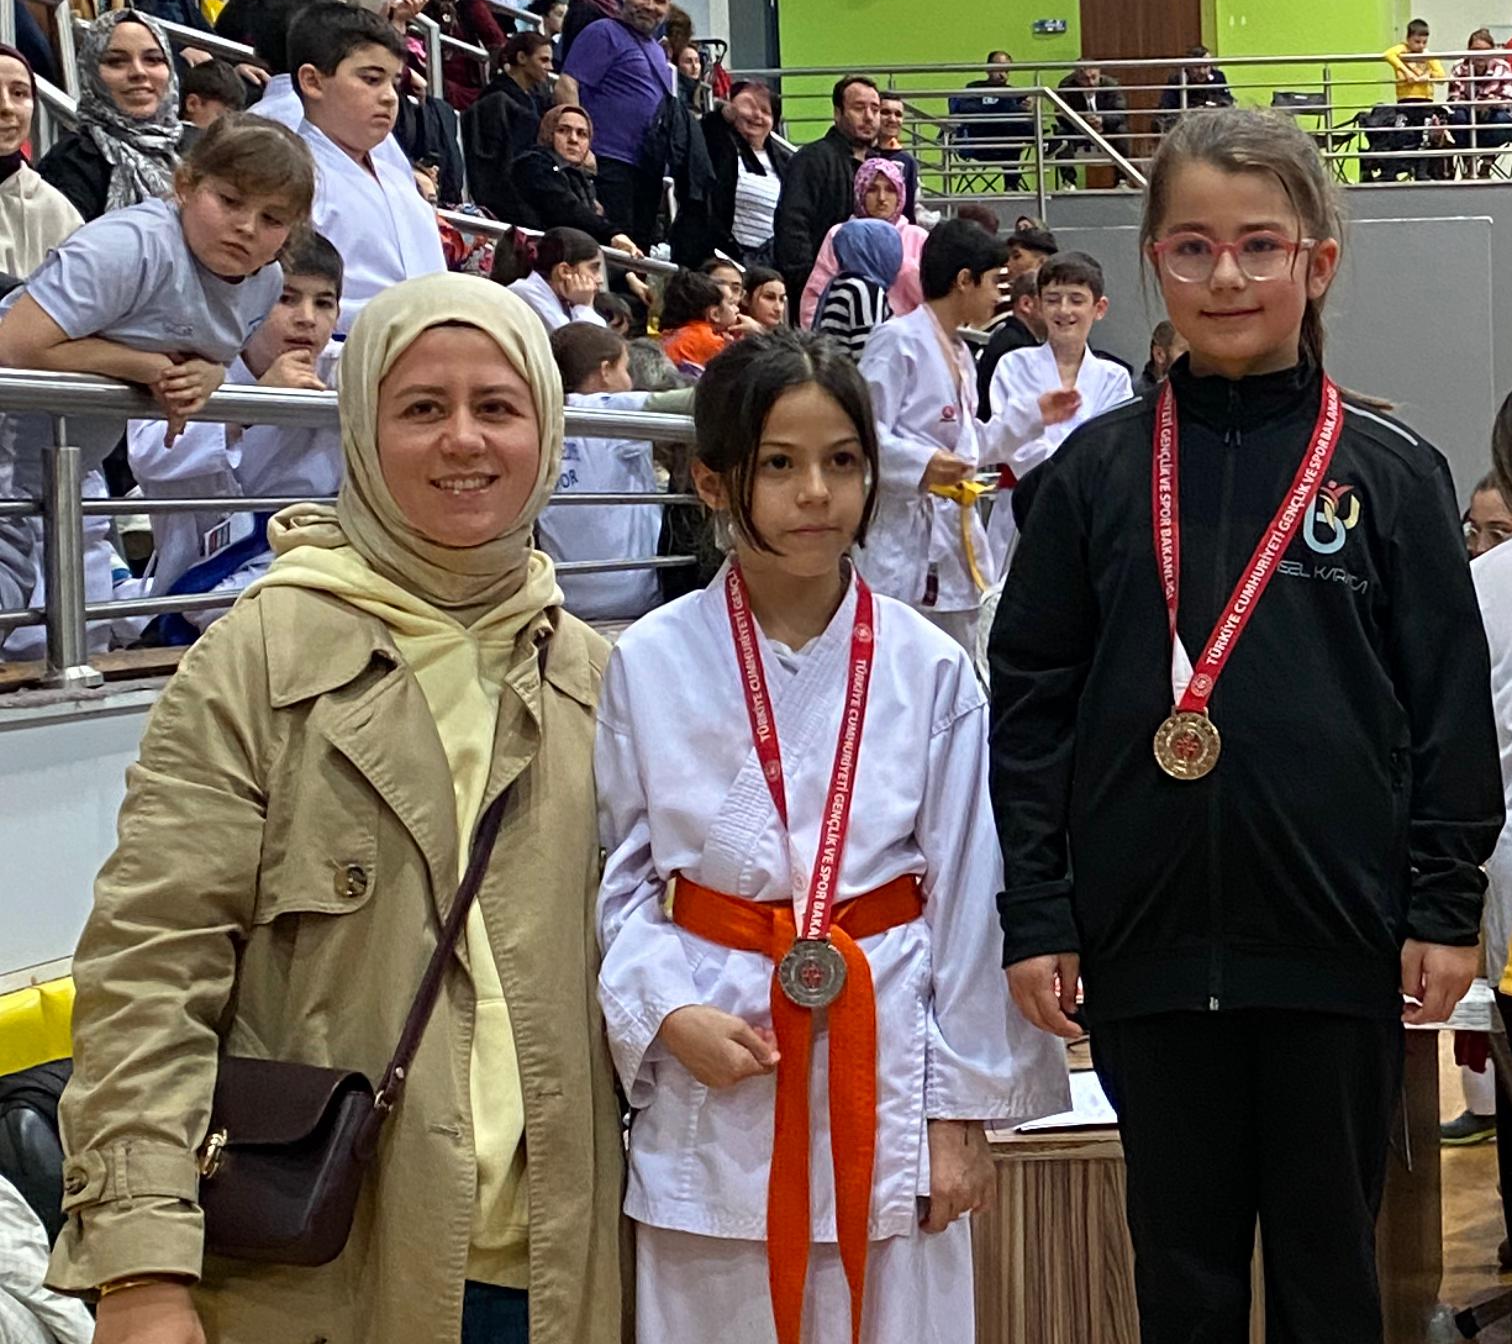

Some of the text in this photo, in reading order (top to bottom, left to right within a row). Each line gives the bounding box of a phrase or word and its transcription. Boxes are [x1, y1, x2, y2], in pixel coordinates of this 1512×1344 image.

[1158, 429, 1172, 476] GENÇLİK
[1302, 466, 1318, 485] VE
[1309, 438, 1329, 470] SPOR
[1158, 478, 1171, 492] VE
[1158, 493, 1171, 526] SPOR
[1277, 481, 1312, 531] GENÇLİK
[1234, 529, 1285, 613] CUMHURİYETİ
[734, 611, 760, 692] CUMHURİYETİ
[1205, 613, 1241, 666] TÜRKİYE
[849, 658, 868, 707] TÜRKİYE
[750, 691, 770, 743] TÜRKİYE
[834, 708, 860, 791] CUMHURİYETİ
[823, 793, 844, 846] GENÇLİK
[820, 845, 835, 864] VE
[813, 864, 832, 899] SPOR
